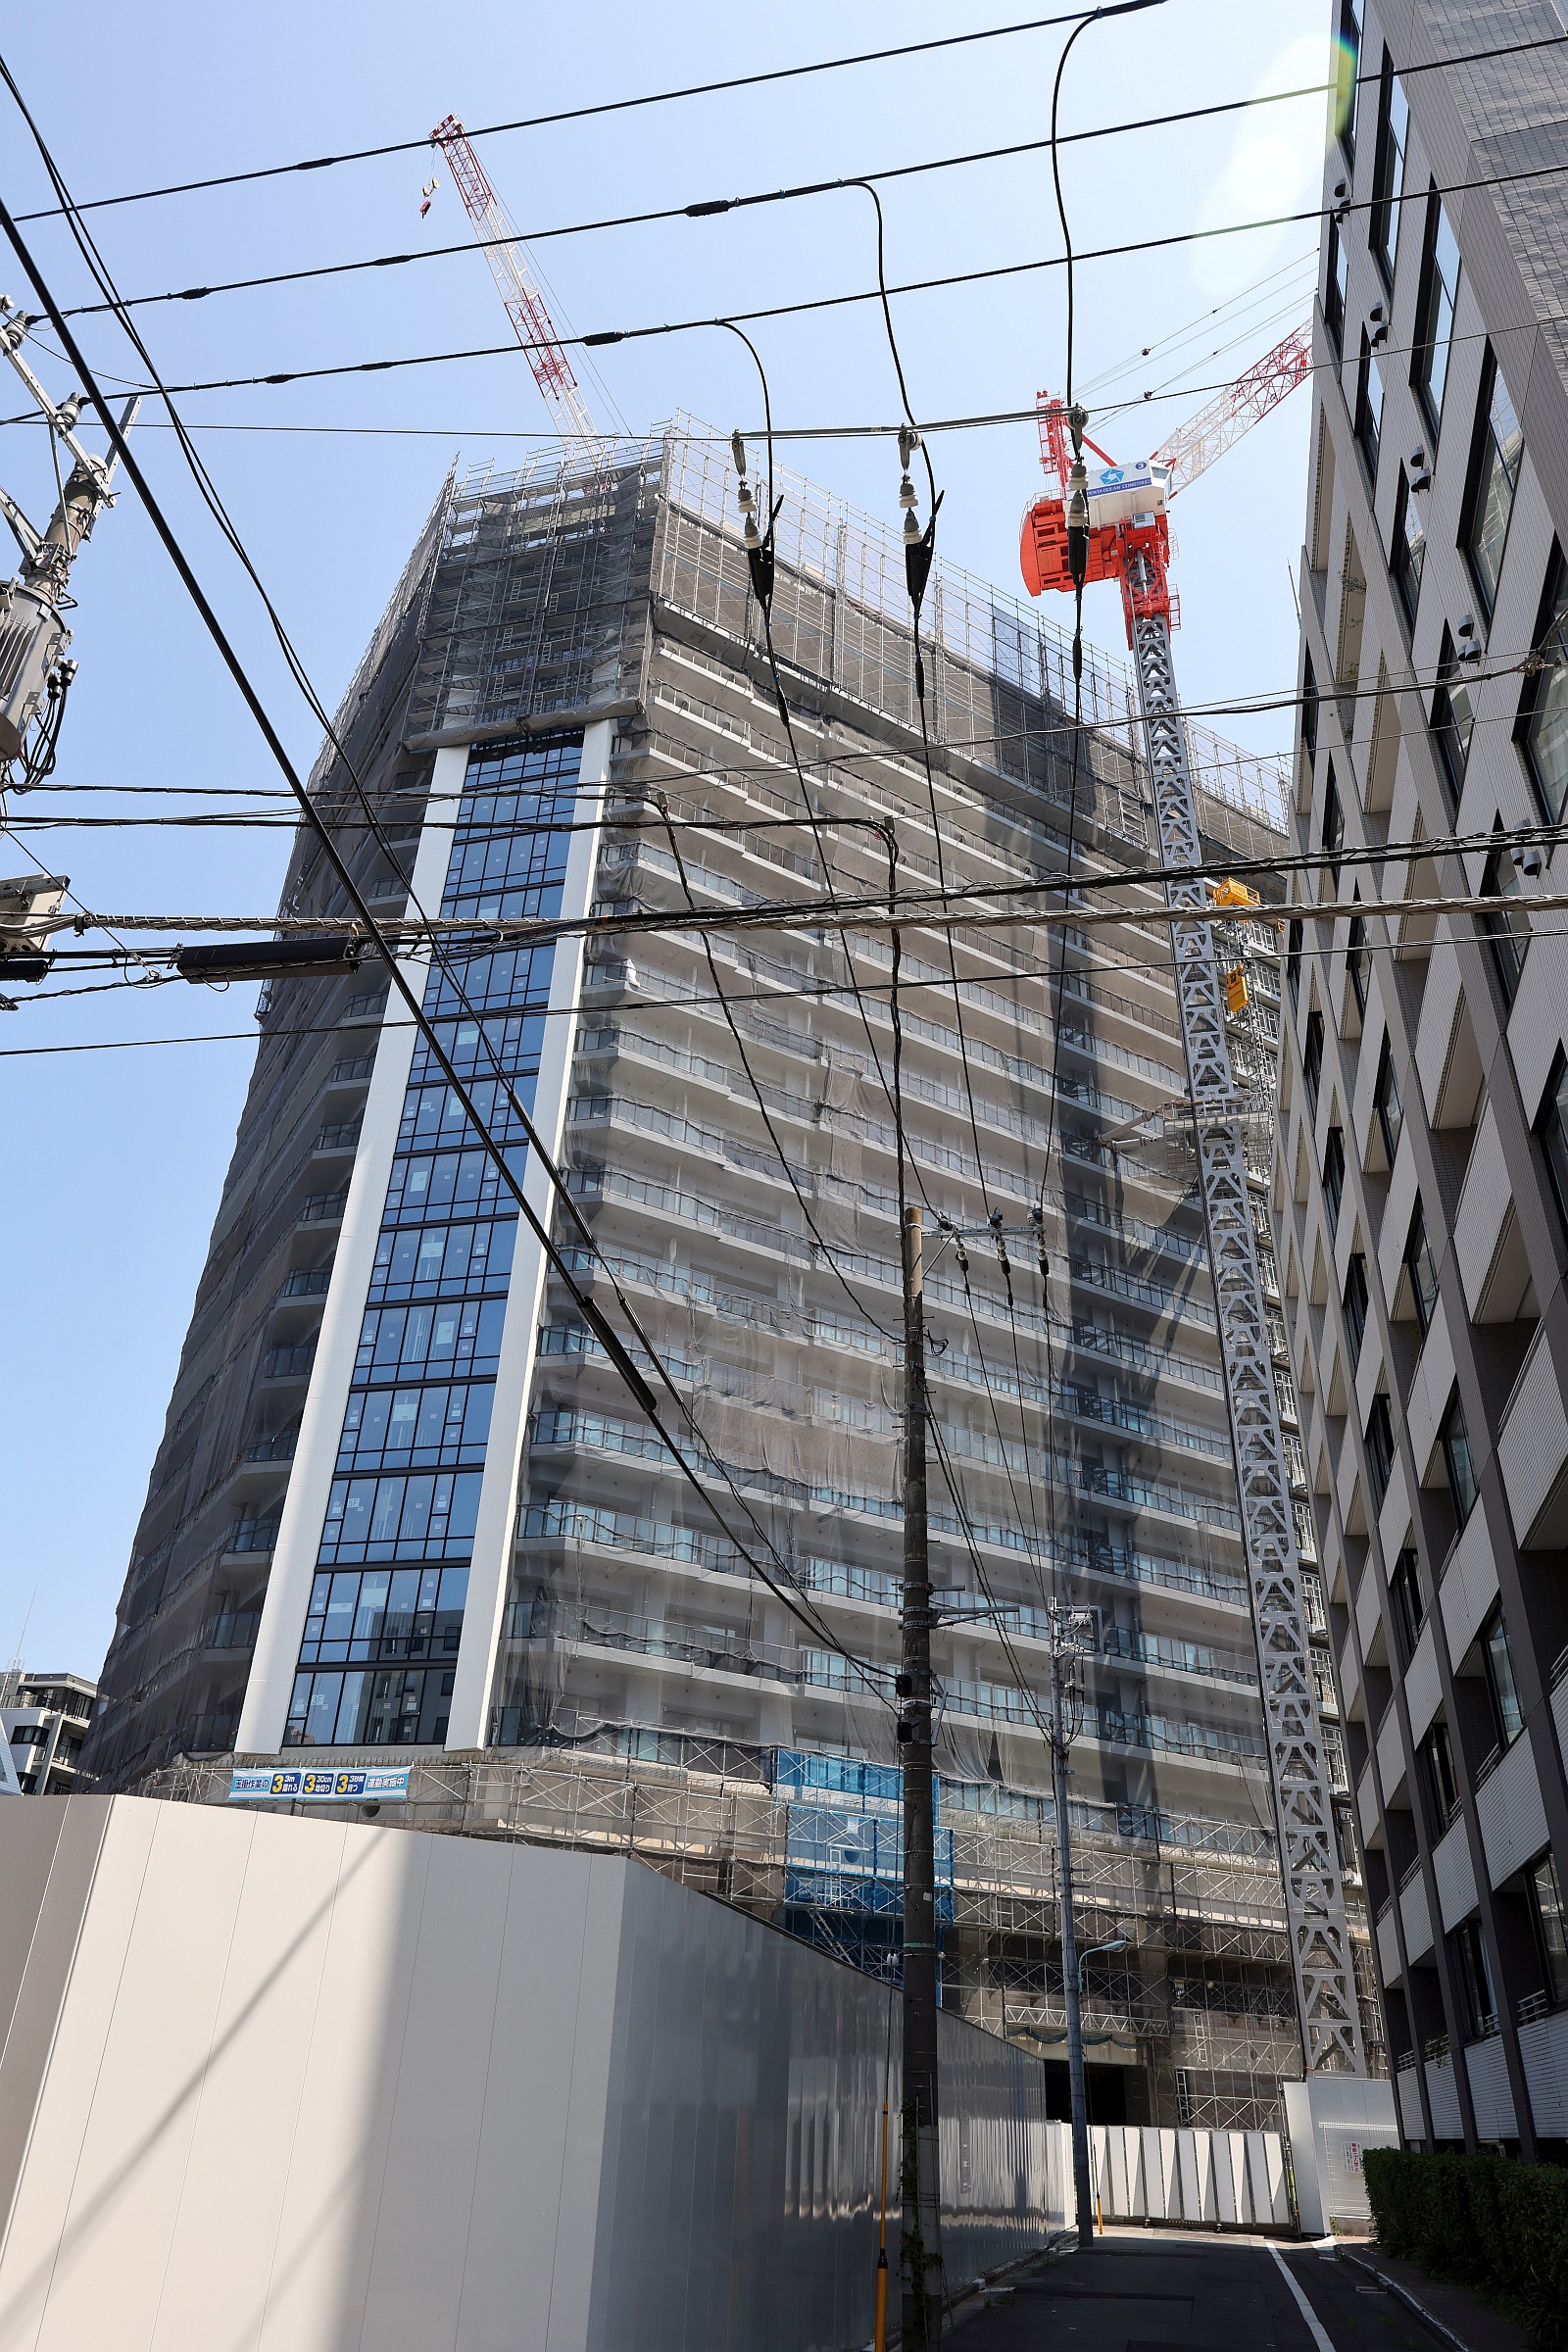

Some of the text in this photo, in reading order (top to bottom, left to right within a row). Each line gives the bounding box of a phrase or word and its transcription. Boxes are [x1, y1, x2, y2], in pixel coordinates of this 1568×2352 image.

[312, 1695, 323, 1704] 3F
[234, 1779, 270, 1788] 玉掛作業の
[271, 1775, 284, 1792] 3
[304, 1775, 317, 1792] 3
[337, 1775, 349, 1792] 3
[368, 1777, 404, 1788] 運動実施中
[315, 1784, 330, 1792] 地切り
[347, 1784, 359, 1792] 待つ
